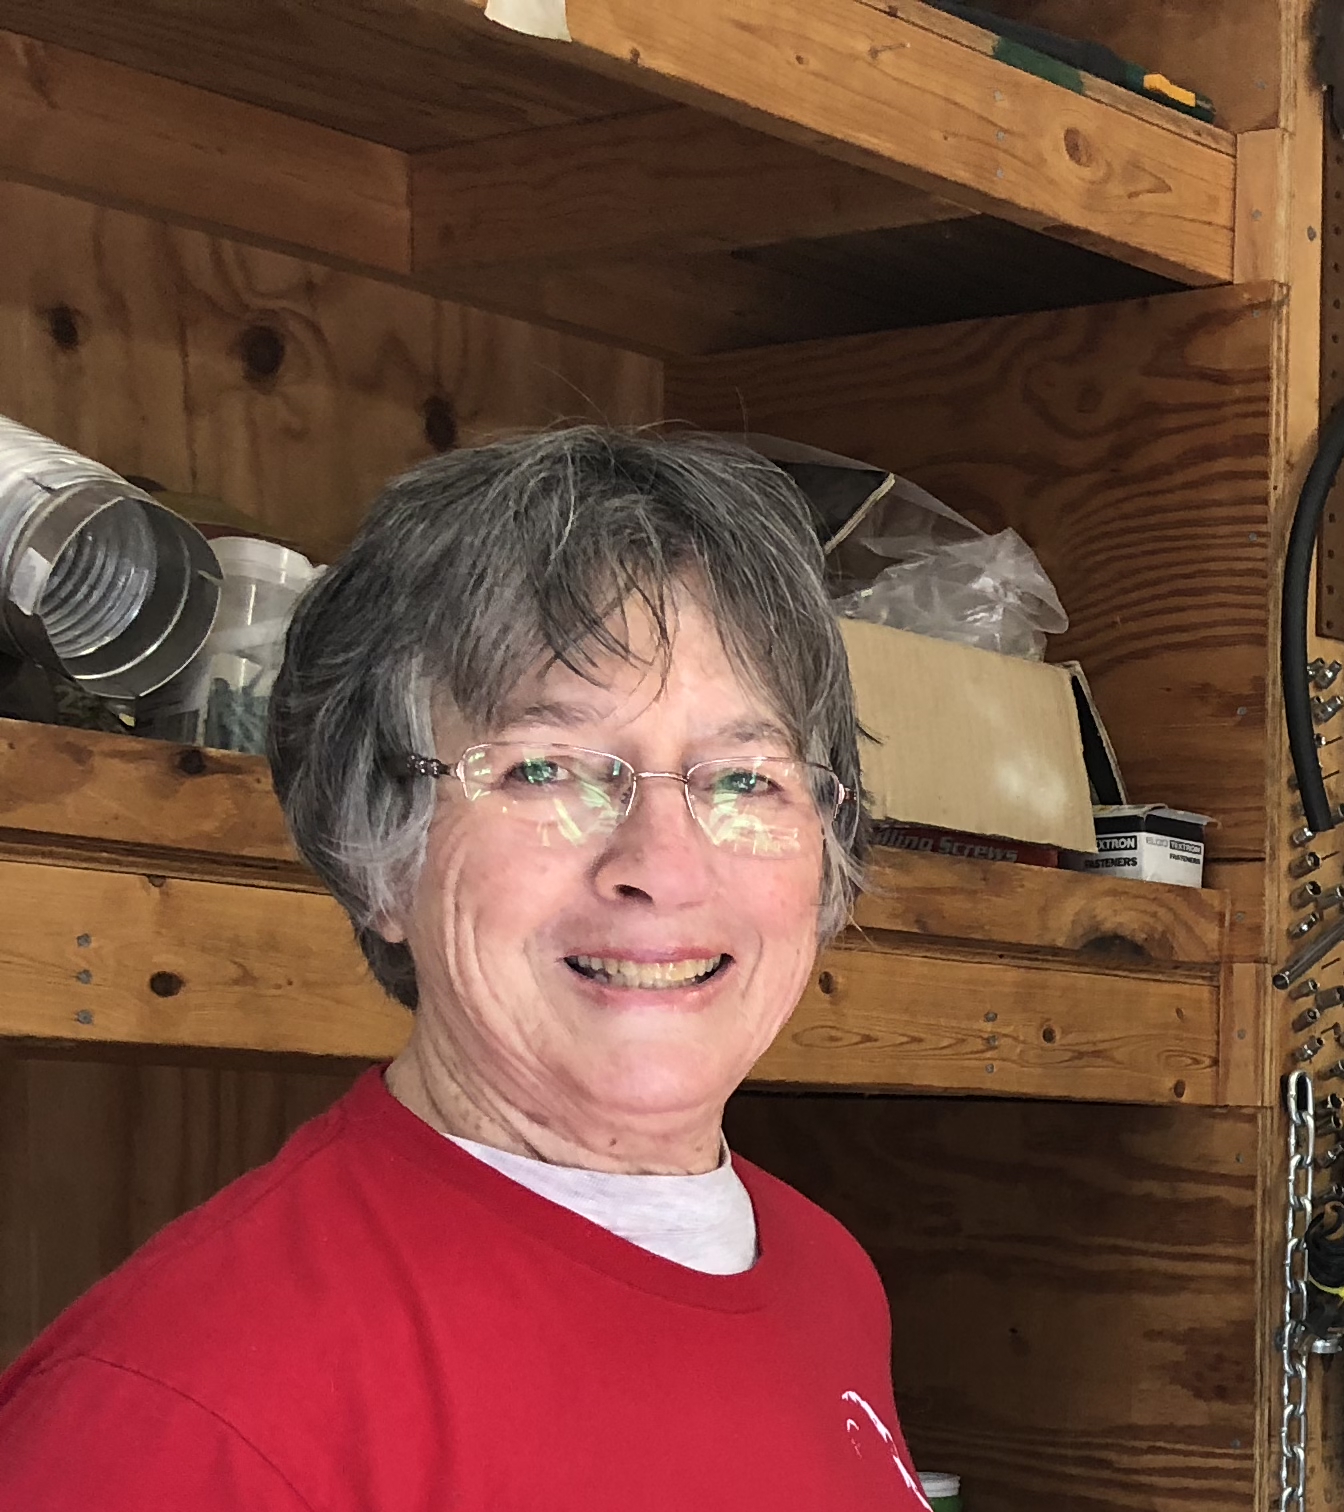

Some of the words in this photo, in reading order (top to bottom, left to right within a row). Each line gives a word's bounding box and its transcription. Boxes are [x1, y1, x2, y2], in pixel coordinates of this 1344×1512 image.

[938, 835, 1017, 863] Screws
[1097, 837, 1137, 851] XTRON
[1085, 855, 1139, 869] FASTENERS
